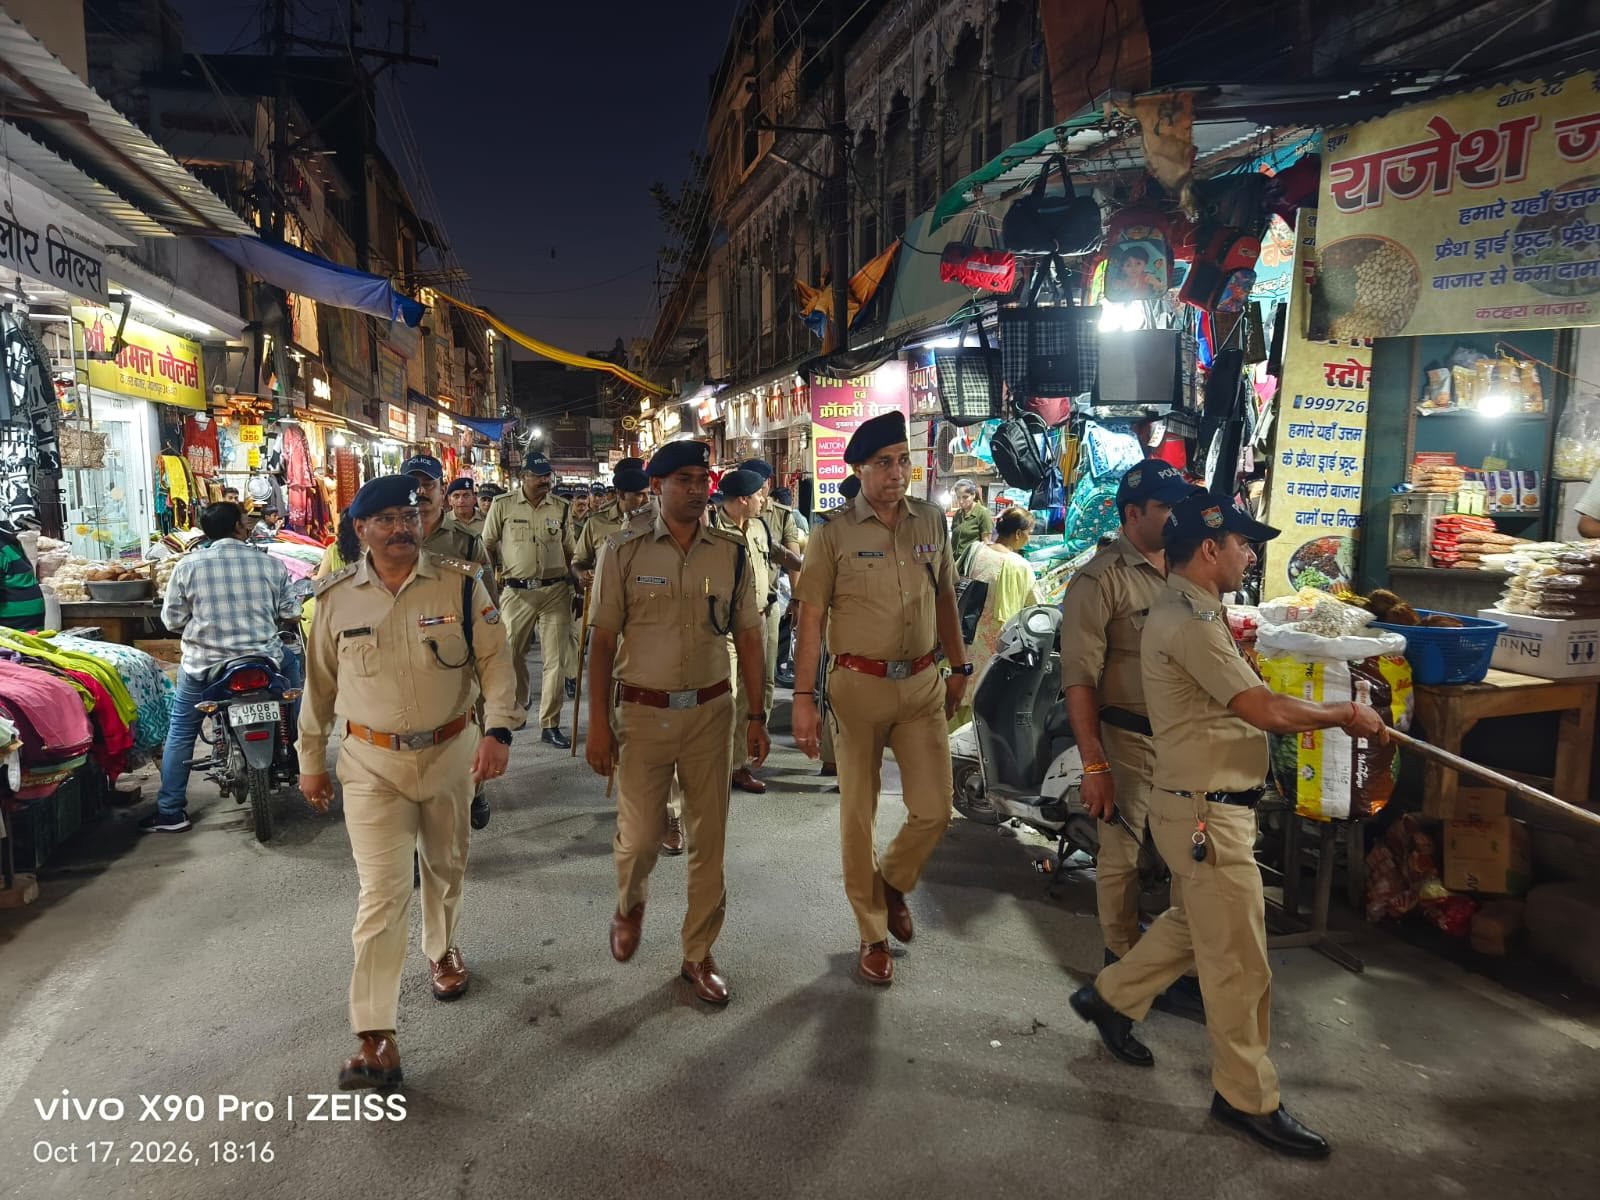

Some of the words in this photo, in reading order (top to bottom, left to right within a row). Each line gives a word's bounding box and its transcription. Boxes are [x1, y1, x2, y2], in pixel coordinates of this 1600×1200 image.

[1329, 114, 1542, 214] राजेश
[1458, 197, 1508, 225] हमारे
[46, 223, 102, 295] मिल्स
[1490, 264, 1508, 286] से
[1512, 265, 1552, 283] कम
[1323, 358, 1373, 389] स्टो
[1304, 396, 1369, 413] 999726
[1288, 421, 1315, 438] हमारे
[1338, 426, 1362, 441] उत्तम
[818, 440, 845, 450] MILTON
[408, 457, 432, 466] POLICE
[1282, 448, 1293, 465] के
[818, 464, 845, 475] cello
[1287, 482, 1295, 496] व
[1297, 480, 1329, 497] मसाले
[1295, 507, 1320, 525] दामों
[1321, 512, 1335, 526] पर
[242, 703, 270, 714] UK08
